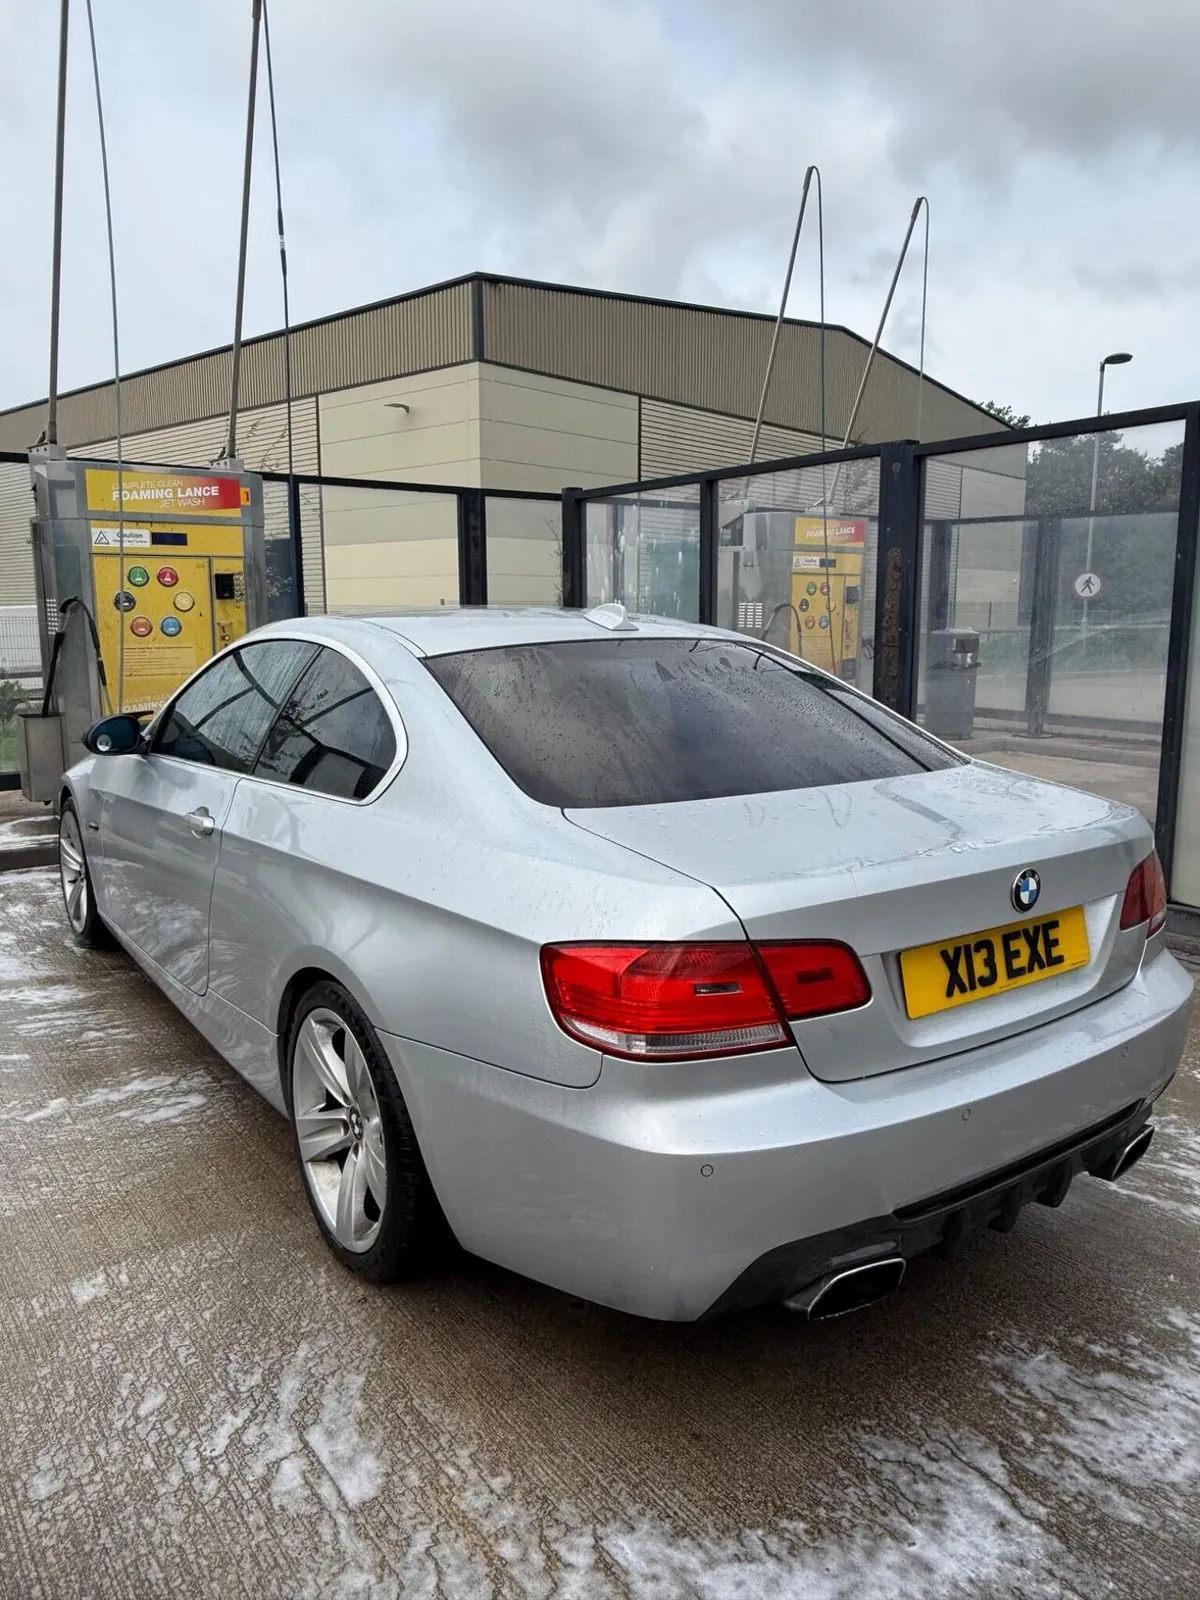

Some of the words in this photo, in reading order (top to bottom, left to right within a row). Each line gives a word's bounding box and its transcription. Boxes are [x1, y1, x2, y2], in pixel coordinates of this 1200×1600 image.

[157, 479, 183, 488] CLEAN
[112, 488, 173, 501] FOAMING
[177, 486, 219, 498] LANCE
[160, 499, 176, 508] JET
[178, 497, 205, 507] WASH
[940, 939, 998, 998] X13
[1002, 920, 1064, 980] EXE
